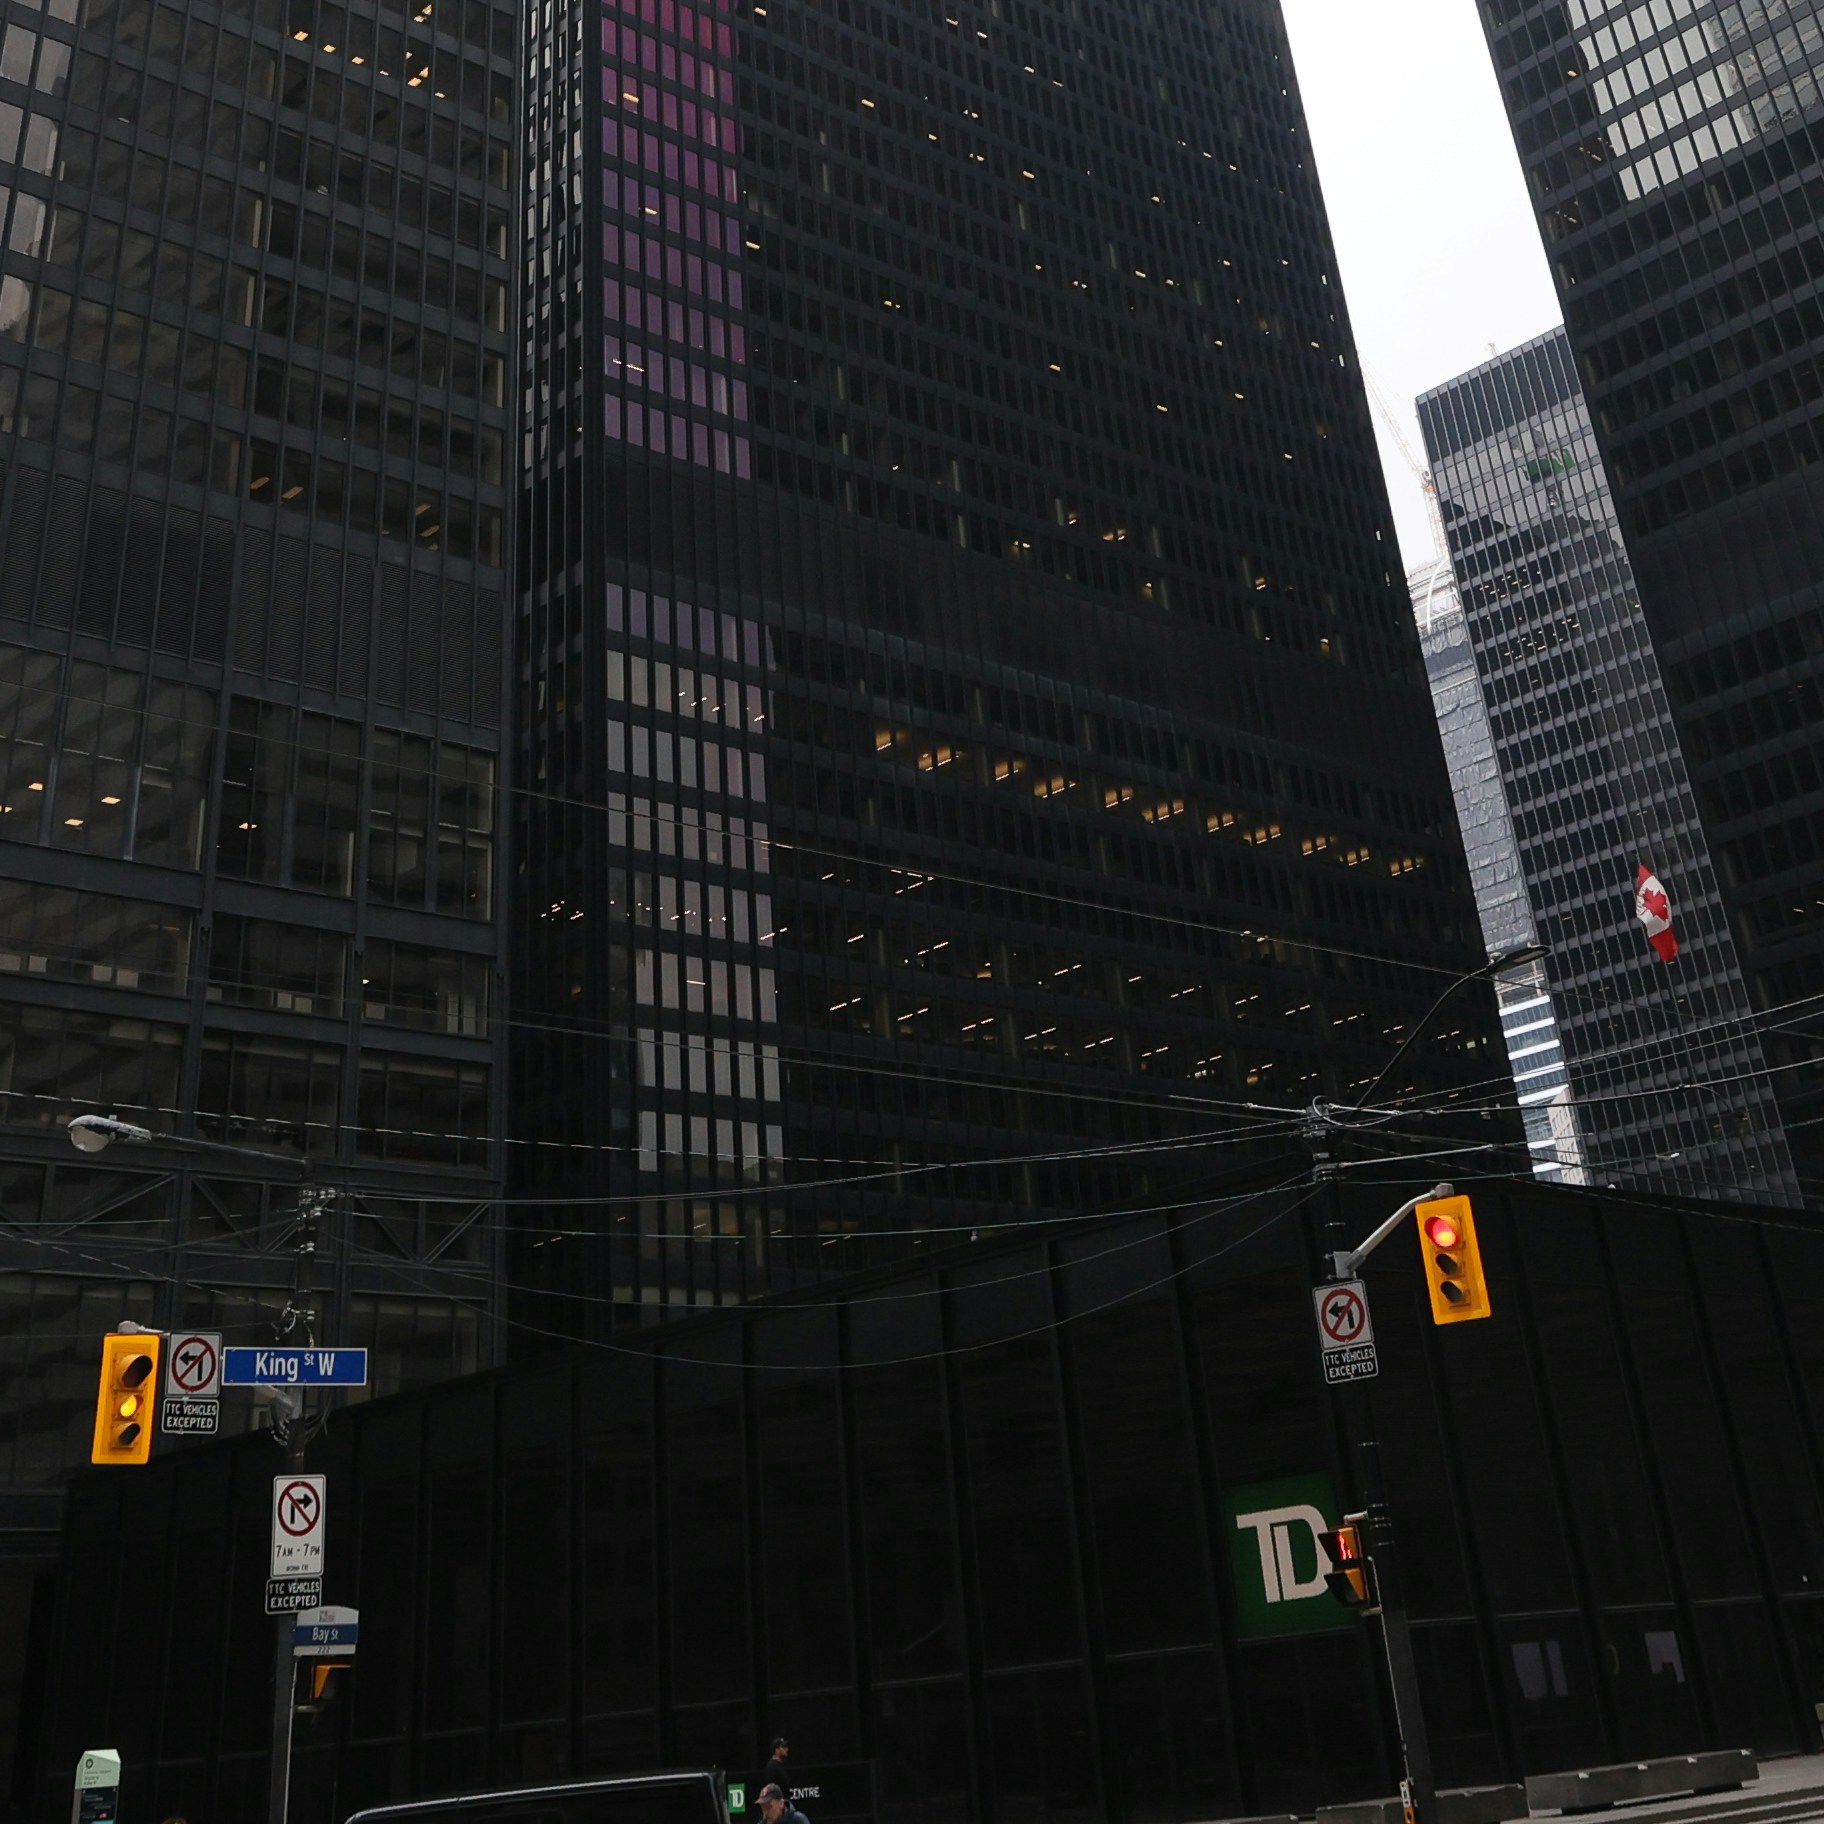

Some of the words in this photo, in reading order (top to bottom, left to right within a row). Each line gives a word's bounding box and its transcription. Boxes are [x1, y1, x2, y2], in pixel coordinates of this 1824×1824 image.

[1325, 1354, 1340, 1366] TTC
[1341, 1348, 1374, 1363] VEHICLES
[255, 1352, 298, 1382] King
[304, 1353, 314, 1366] St
[318, 1353, 335, 1376] W
[1329, 1361, 1374, 1378] EXCEPTED
[166, 1403, 181, 1415] TTC
[183, 1404, 217, 1416] VEHICLES
[166, 1416, 214, 1429] EXCEPTED
[1235, 1504, 1334, 1604] TD
[269, 1583, 284, 1594] TTC
[288, 1581, 320, 1593] VEHICLES
[270, 1595, 318, 1608] EXCEPTED
[312, 1627, 330, 1644] Bay
[331, 1629, 339, 1639] St
[729, 1788, 745, 1808] TD
[789, 1786, 820, 1800] CENTRE
